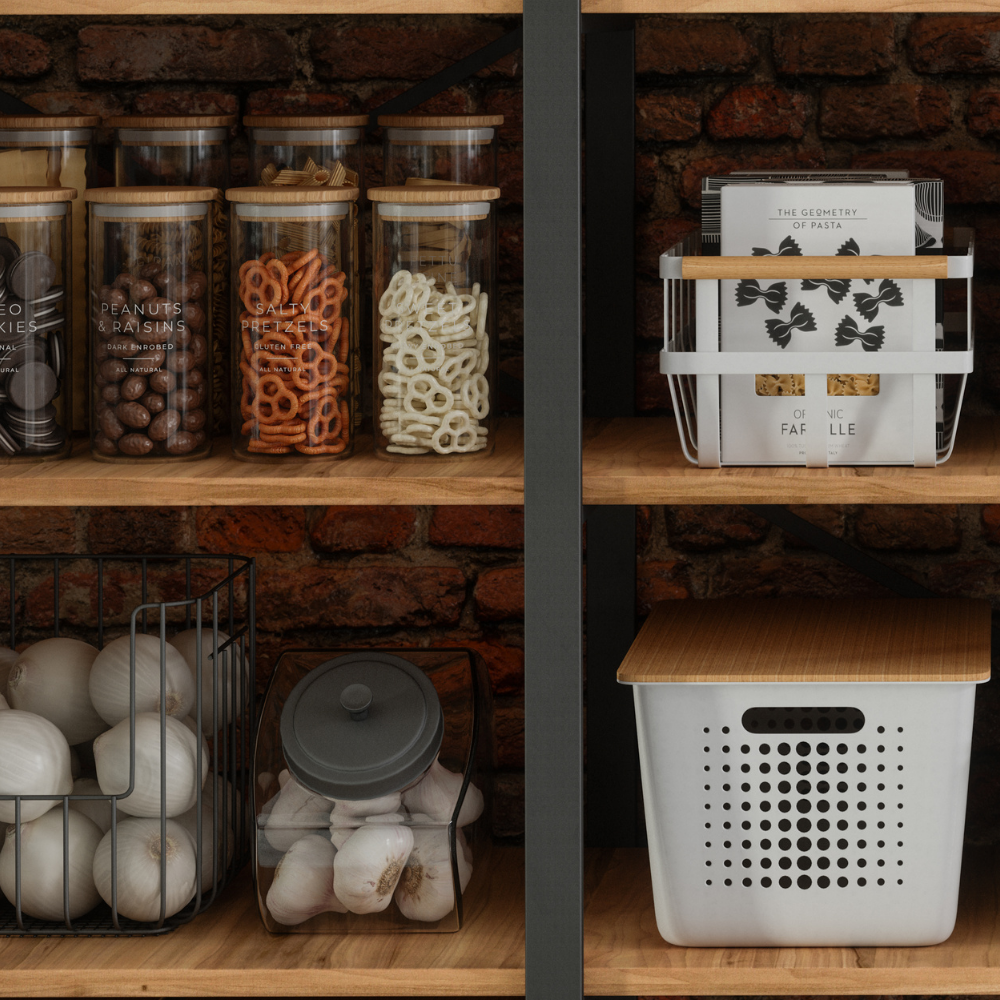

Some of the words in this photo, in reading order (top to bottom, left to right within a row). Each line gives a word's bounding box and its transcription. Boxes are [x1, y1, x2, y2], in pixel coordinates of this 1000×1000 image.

[101, 303, 182, 315] PEANUTS
[256, 303, 310, 315] SALTY
[98, 321, 106, 332] &
[113, 320, 185, 333] RAISINS
[242, 320, 328, 332] PRETZELS
[781, 423, 855, 435] FARLLE
